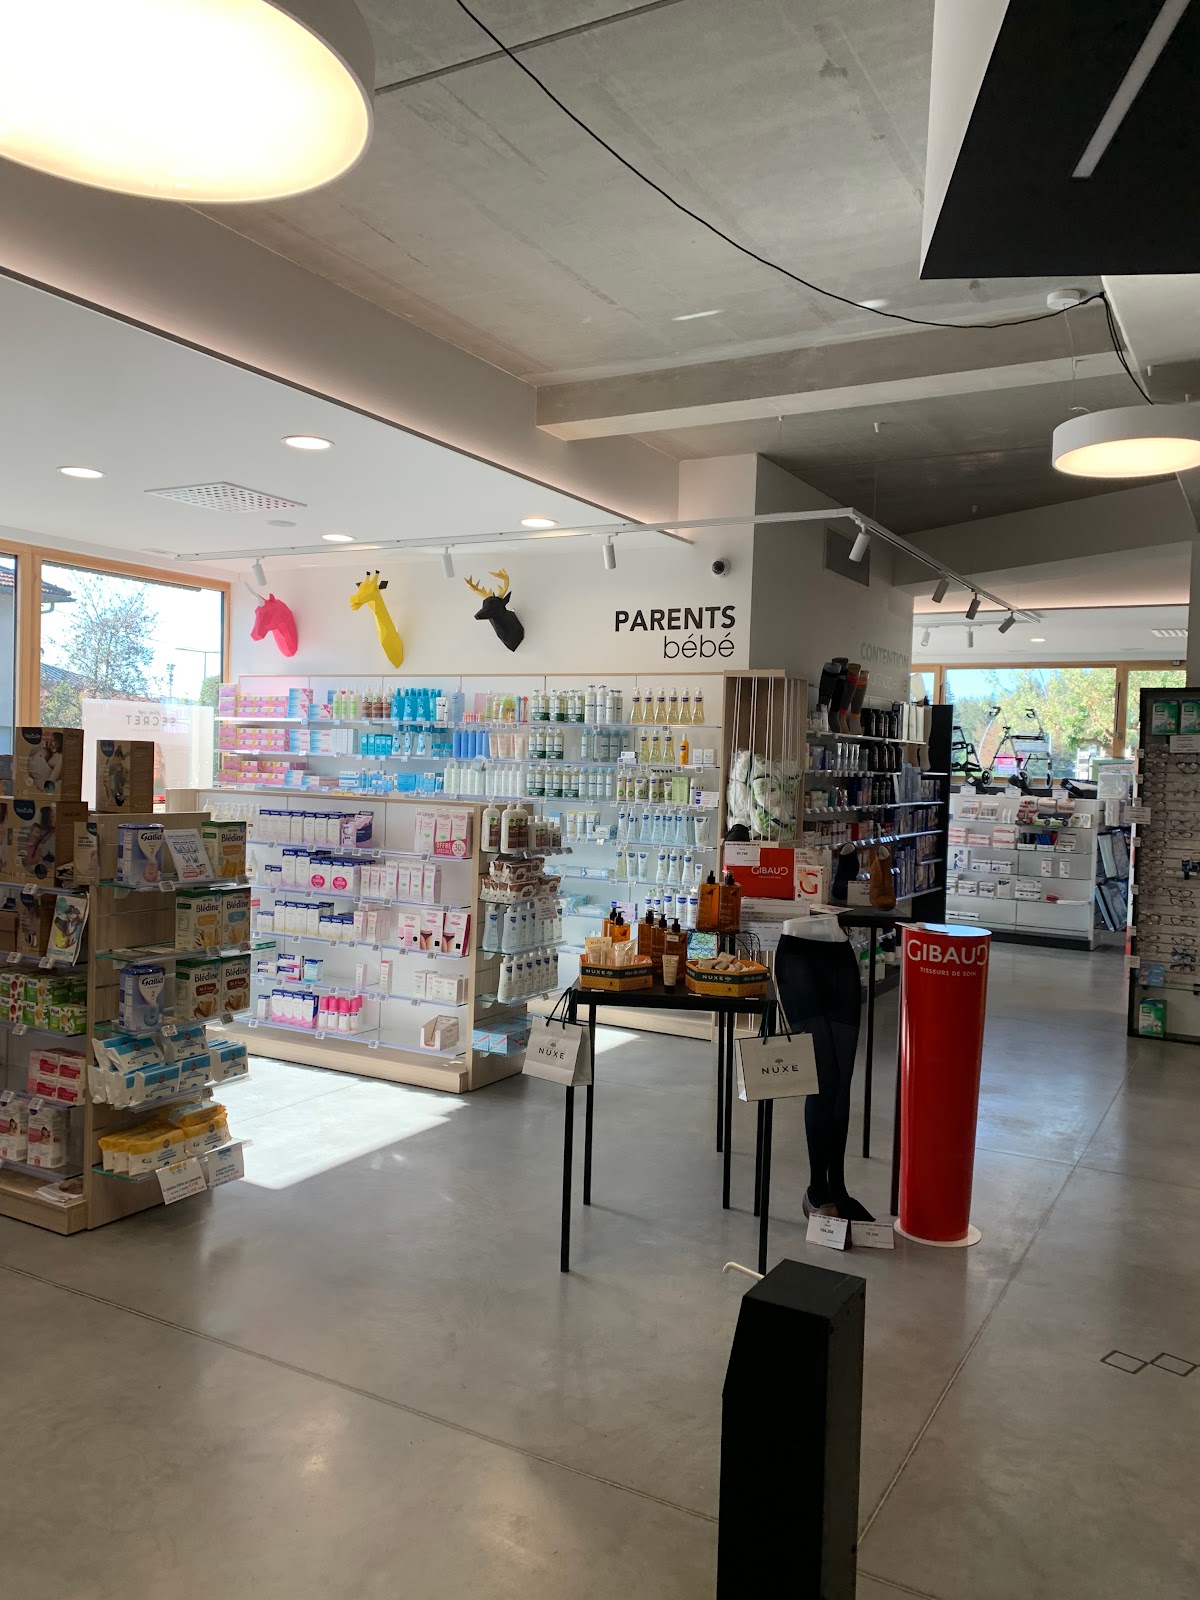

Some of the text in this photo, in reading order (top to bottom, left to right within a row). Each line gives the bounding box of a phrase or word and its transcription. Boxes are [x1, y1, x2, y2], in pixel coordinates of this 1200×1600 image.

[614, 605, 736, 632] PARENTS
[663, 631, 735, 659] bébé
[860, 641, 910, 669] CONTENTION
[751, 866, 789, 876] GIBAUD
[196, 903, 219, 913] Blédine
[226, 900, 249, 910] Blédine
[907, 939, 988, 966] GIBAUD
[225, 966, 249, 977] Blédine
[920, 966, 950, 976] TISSEURS
[194, 972, 219, 983] Blédine
[151, 990, 156, 998] 2
[538, 1047, 565, 1060] NUXE
[761, 1064, 800, 1075] NUXE
